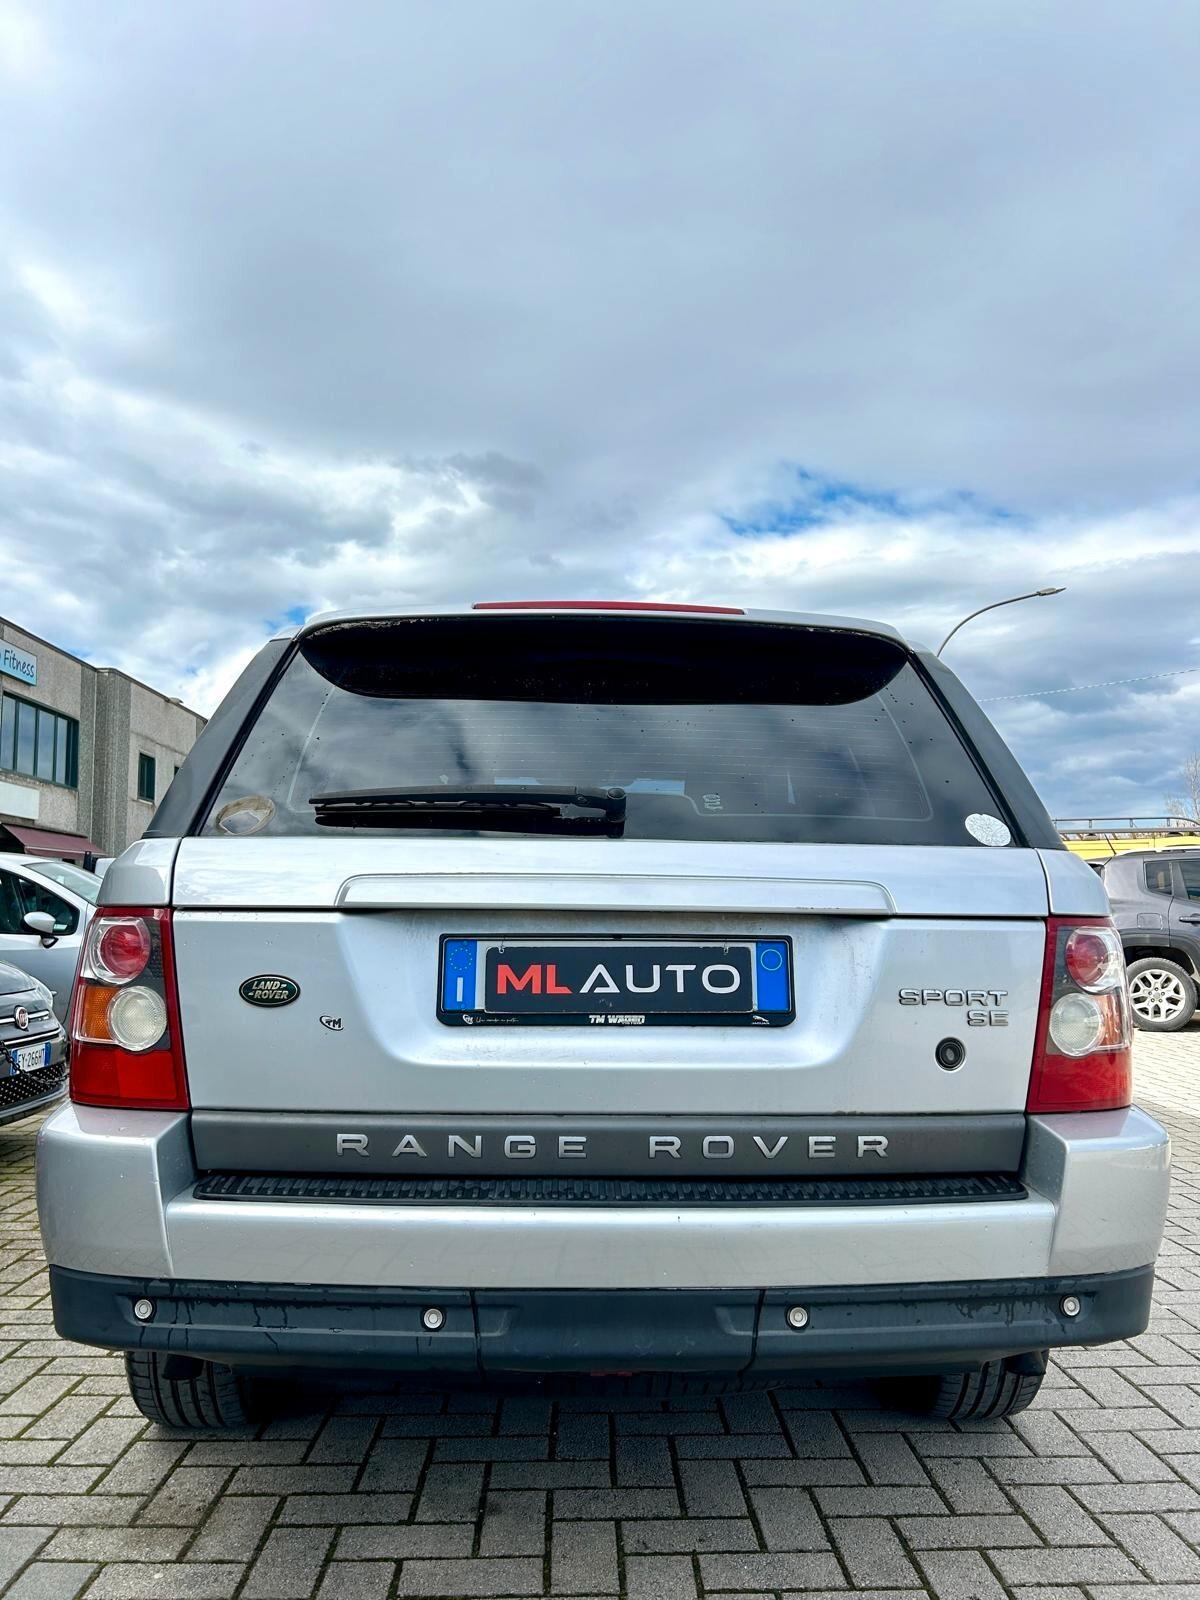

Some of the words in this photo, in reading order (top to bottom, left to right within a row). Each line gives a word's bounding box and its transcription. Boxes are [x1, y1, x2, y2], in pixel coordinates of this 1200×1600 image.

[3, 649, 35, 678] Fitness
[252, 980, 281, 990] LAND
[496, 964, 573, 994] ML
[579, 963, 741, 994] AUTO
[254, 990, 289, 999] ROVER
[899, 988, 1008, 1006] SPORT
[589, 1014, 605, 1024] TM
[967, 1010, 1008, 1026] SE
[336, 1133, 588, 1158] RANGE
[649, 1135, 889, 1159] ROVER
